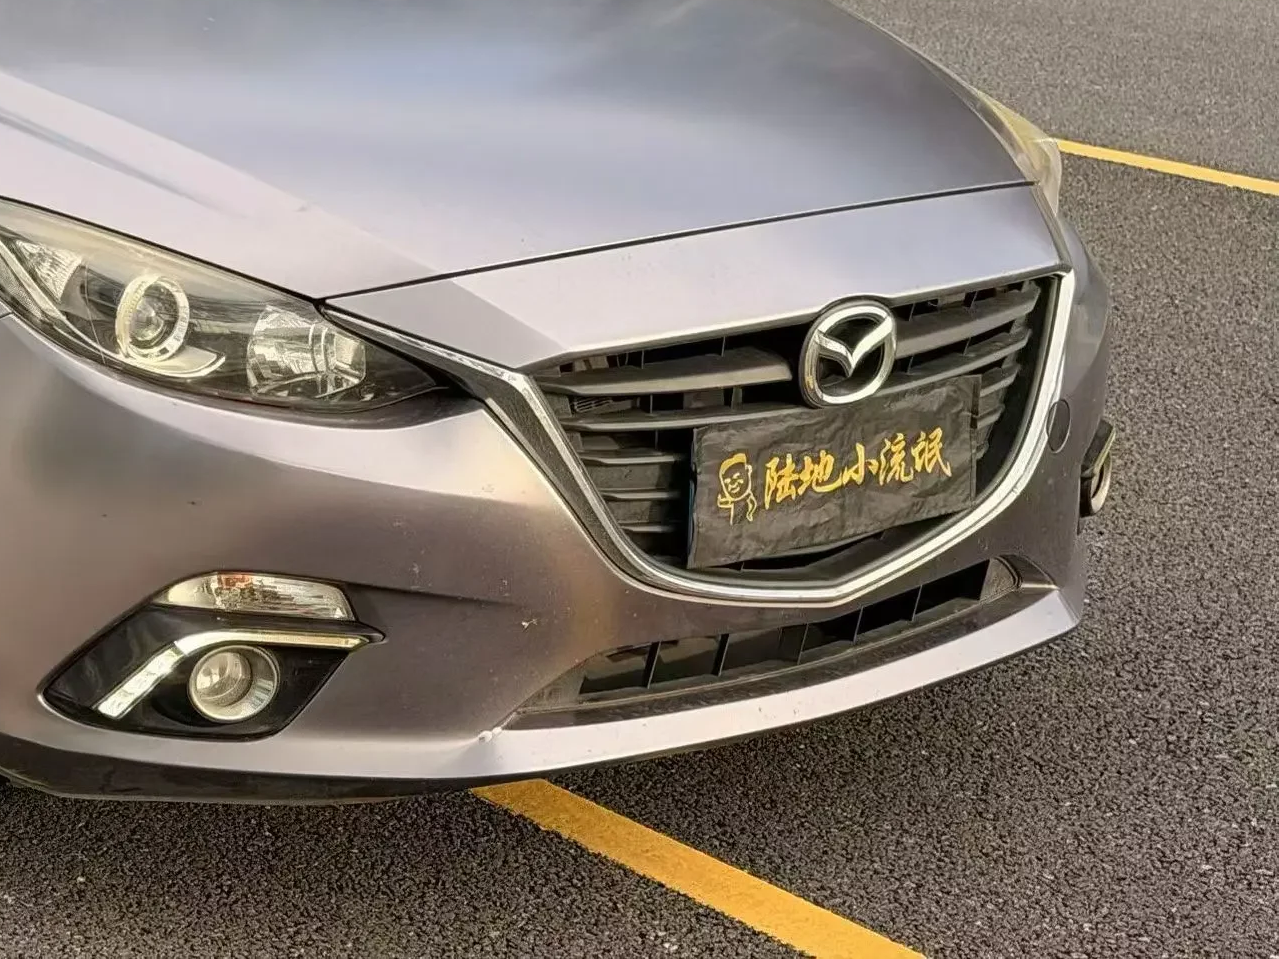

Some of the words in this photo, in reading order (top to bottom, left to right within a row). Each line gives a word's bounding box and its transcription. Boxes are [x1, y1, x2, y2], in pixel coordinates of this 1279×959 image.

[764, 427, 952, 510] 陆地小流氓
